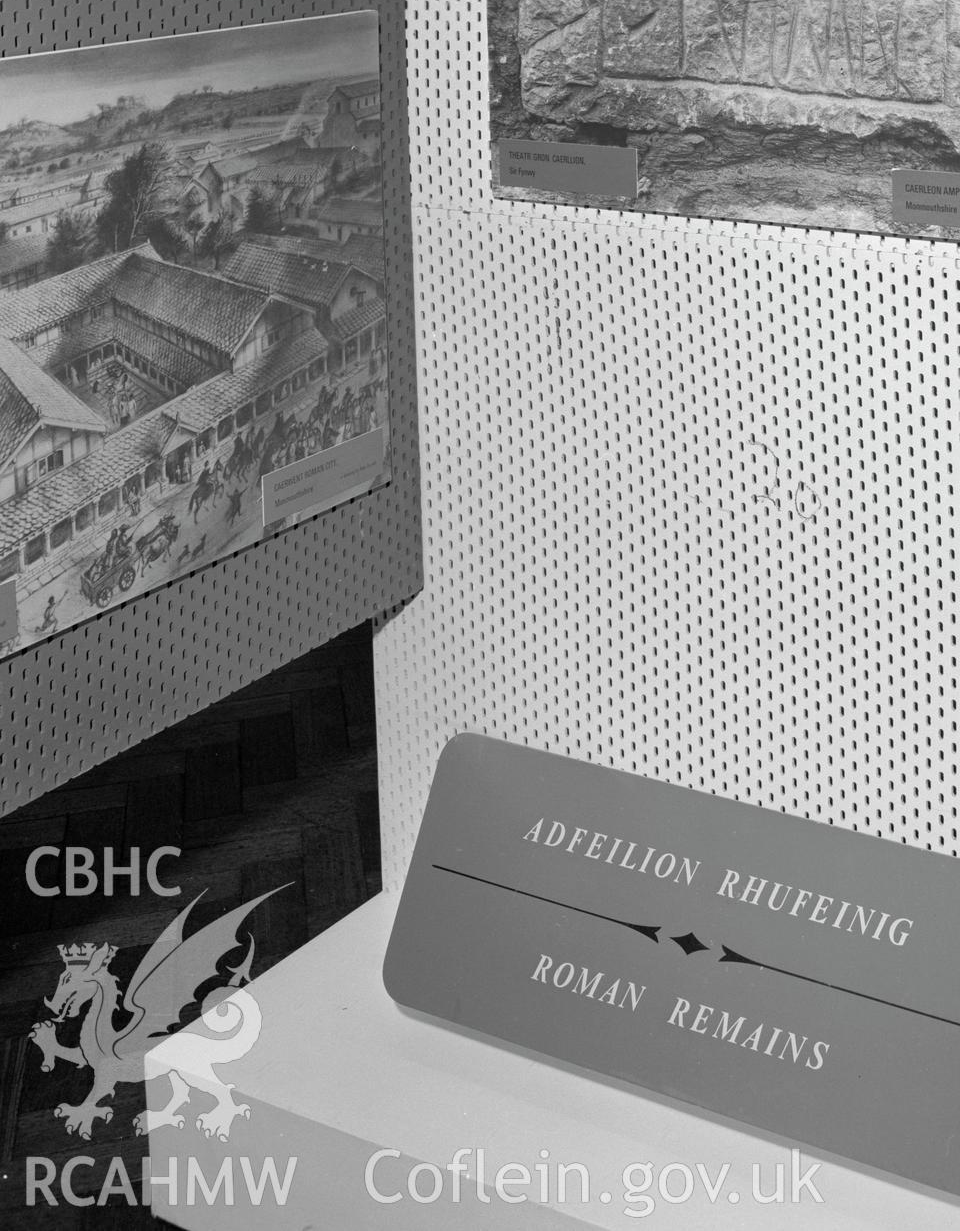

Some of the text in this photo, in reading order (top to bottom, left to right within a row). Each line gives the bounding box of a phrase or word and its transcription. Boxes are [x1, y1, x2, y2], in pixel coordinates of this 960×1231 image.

[905, 183, 942, 195] CAERLEON
[905, 201, 958, 214] Monmouthshire
[522, 817, 914, 947] ADFEILION RHUFEINIG
[530, 954, 831, 1070] ROMAN REMAINS
